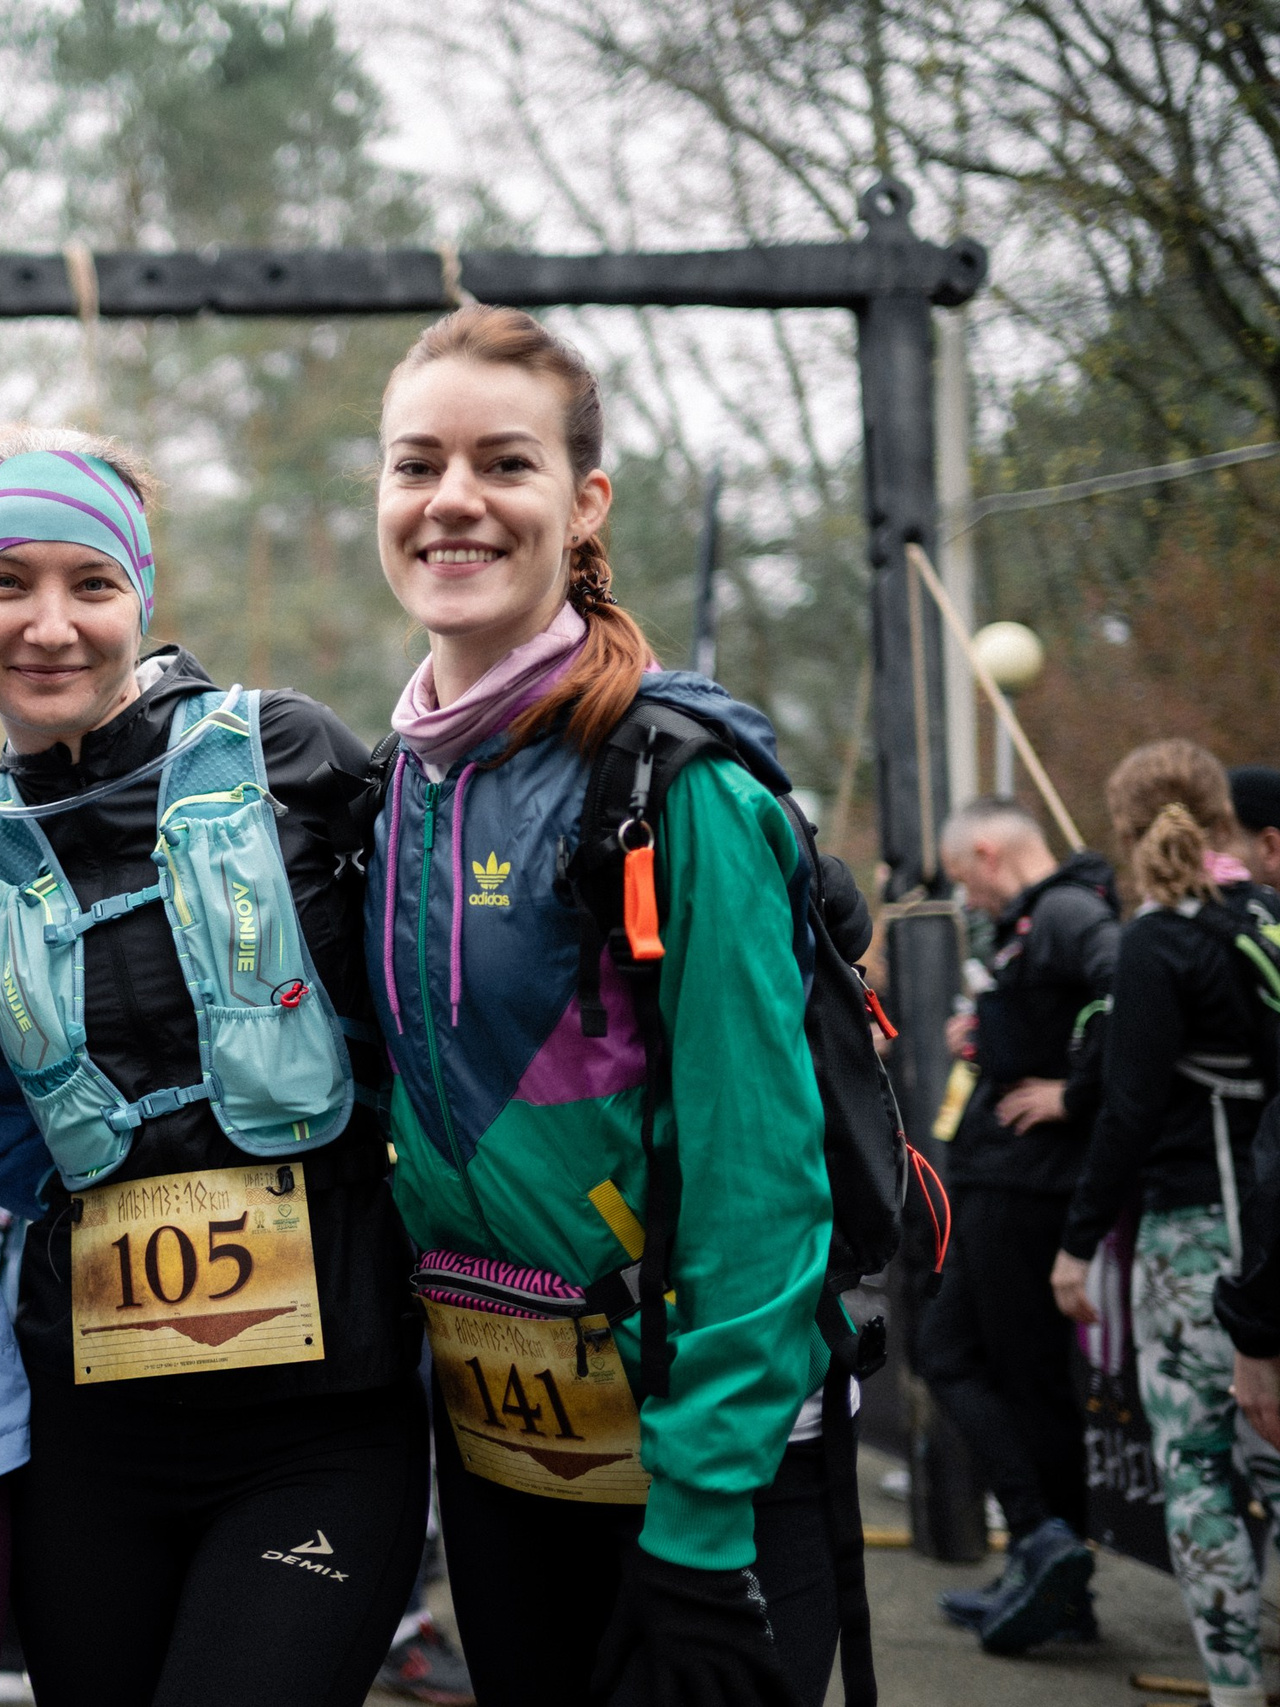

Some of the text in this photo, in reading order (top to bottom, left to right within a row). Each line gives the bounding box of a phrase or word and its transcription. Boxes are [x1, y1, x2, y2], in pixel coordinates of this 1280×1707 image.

[231, 881, 254, 973] AONIJIE
[469, 892, 509, 906] adidas
[112, 1210, 254, 1310] 105
[467, 1357, 584, 1440] 141
[262, 1551, 349, 1582] DEMIX
